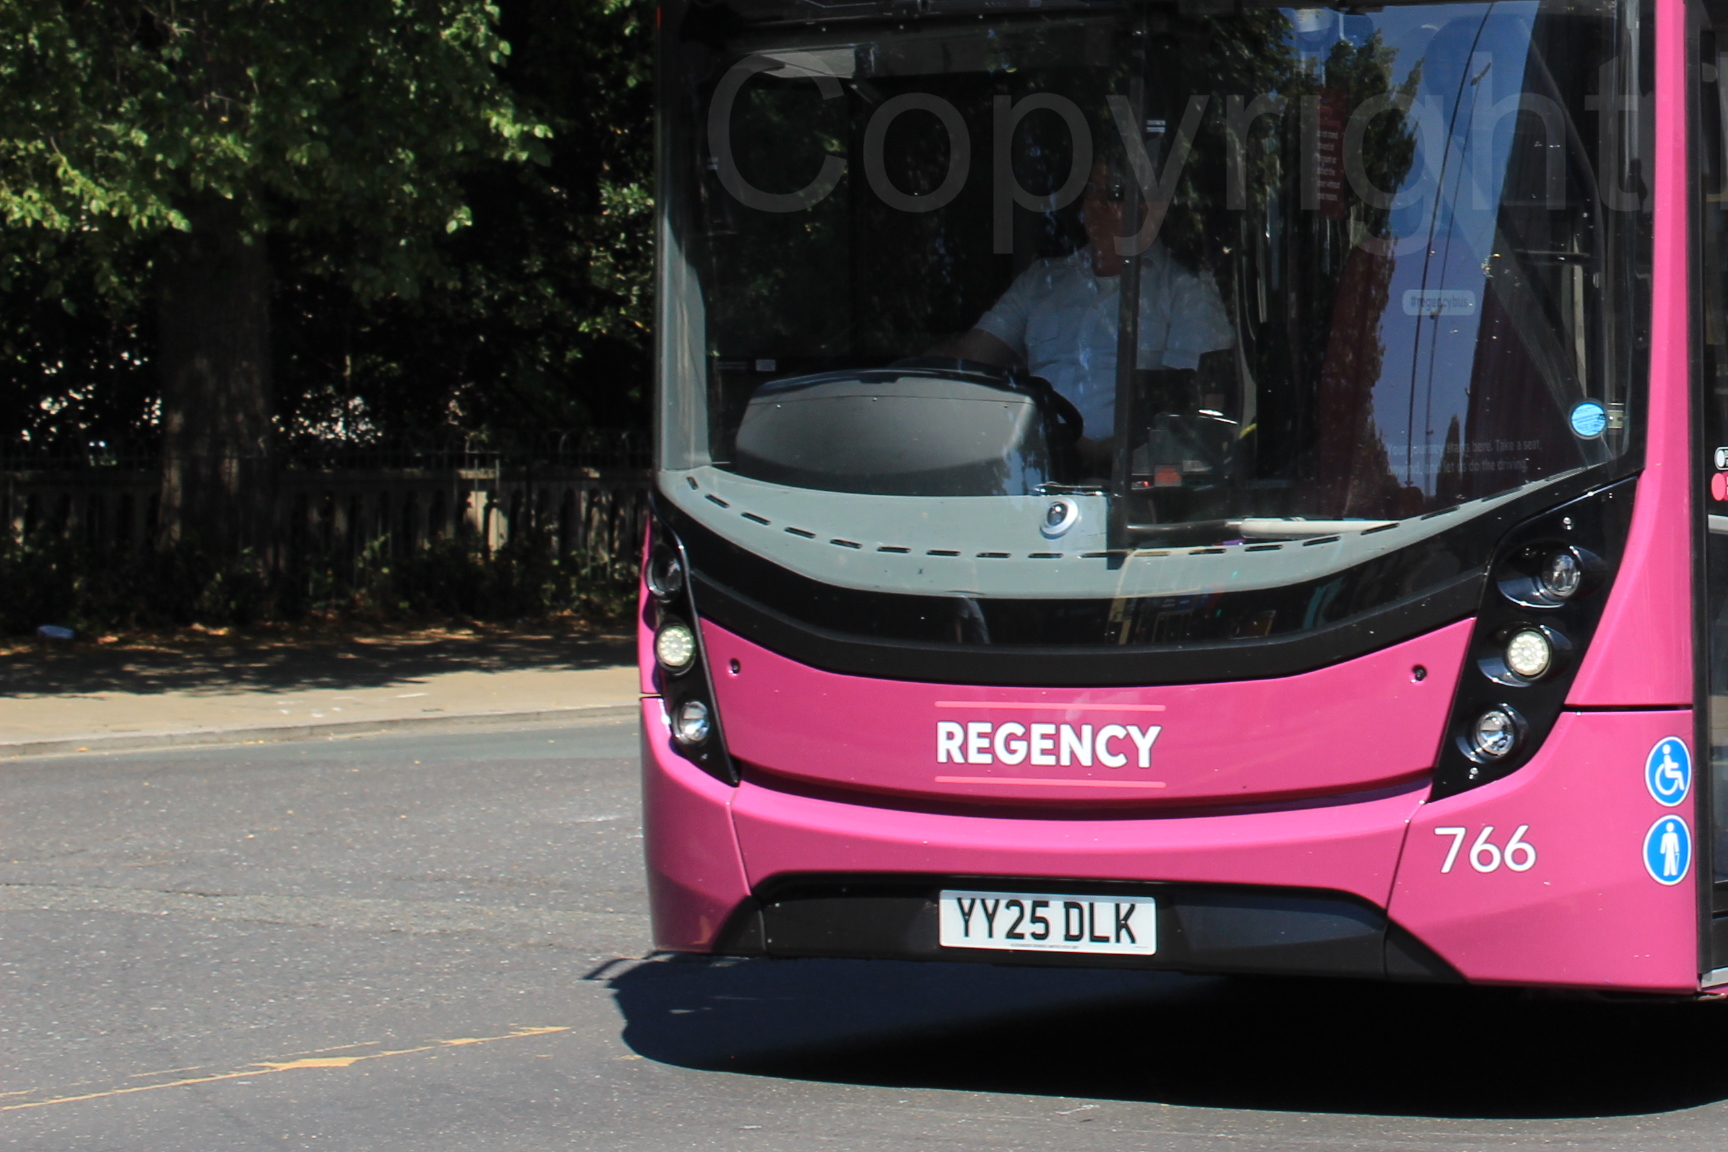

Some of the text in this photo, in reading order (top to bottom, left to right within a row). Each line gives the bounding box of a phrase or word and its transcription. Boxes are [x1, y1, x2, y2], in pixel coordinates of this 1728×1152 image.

[936, 720, 1162, 769] REGENCY
[1434, 824, 1537, 873] 766
[957, 897, 1136, 944] YY25 DLK
